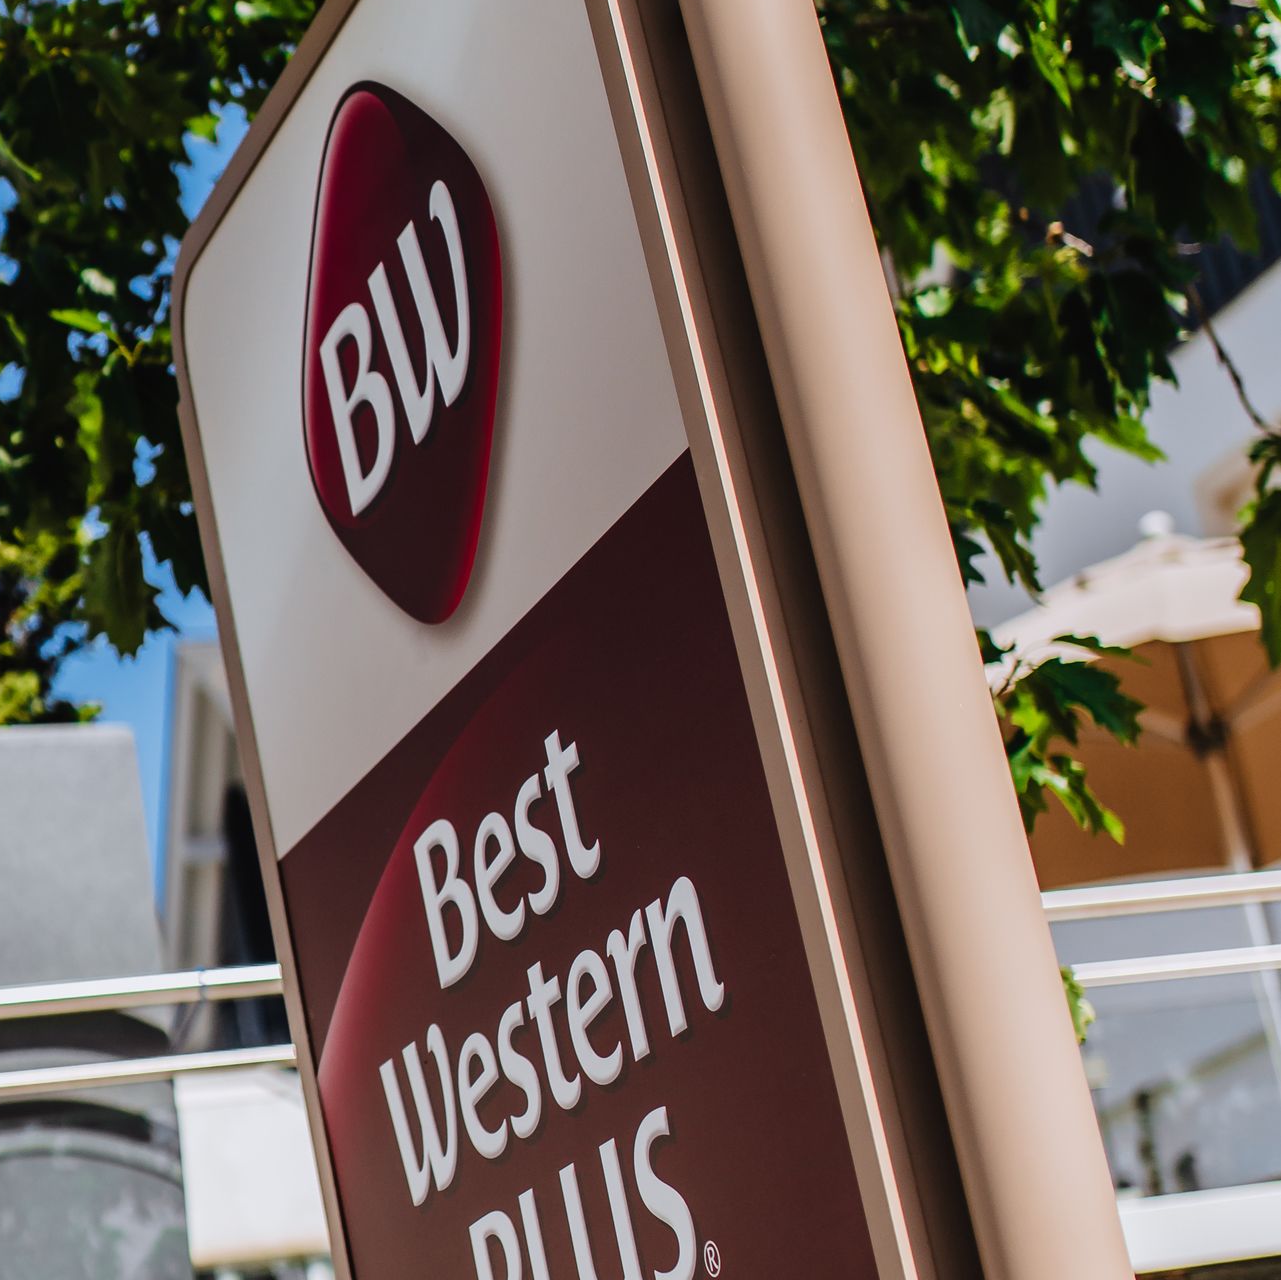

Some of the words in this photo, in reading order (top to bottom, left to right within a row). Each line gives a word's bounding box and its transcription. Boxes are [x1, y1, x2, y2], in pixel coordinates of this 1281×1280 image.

[320, 180, 470, 517] BW
[413, 729, 600, 989] Best
[379, 876, 724, 1206] Western
